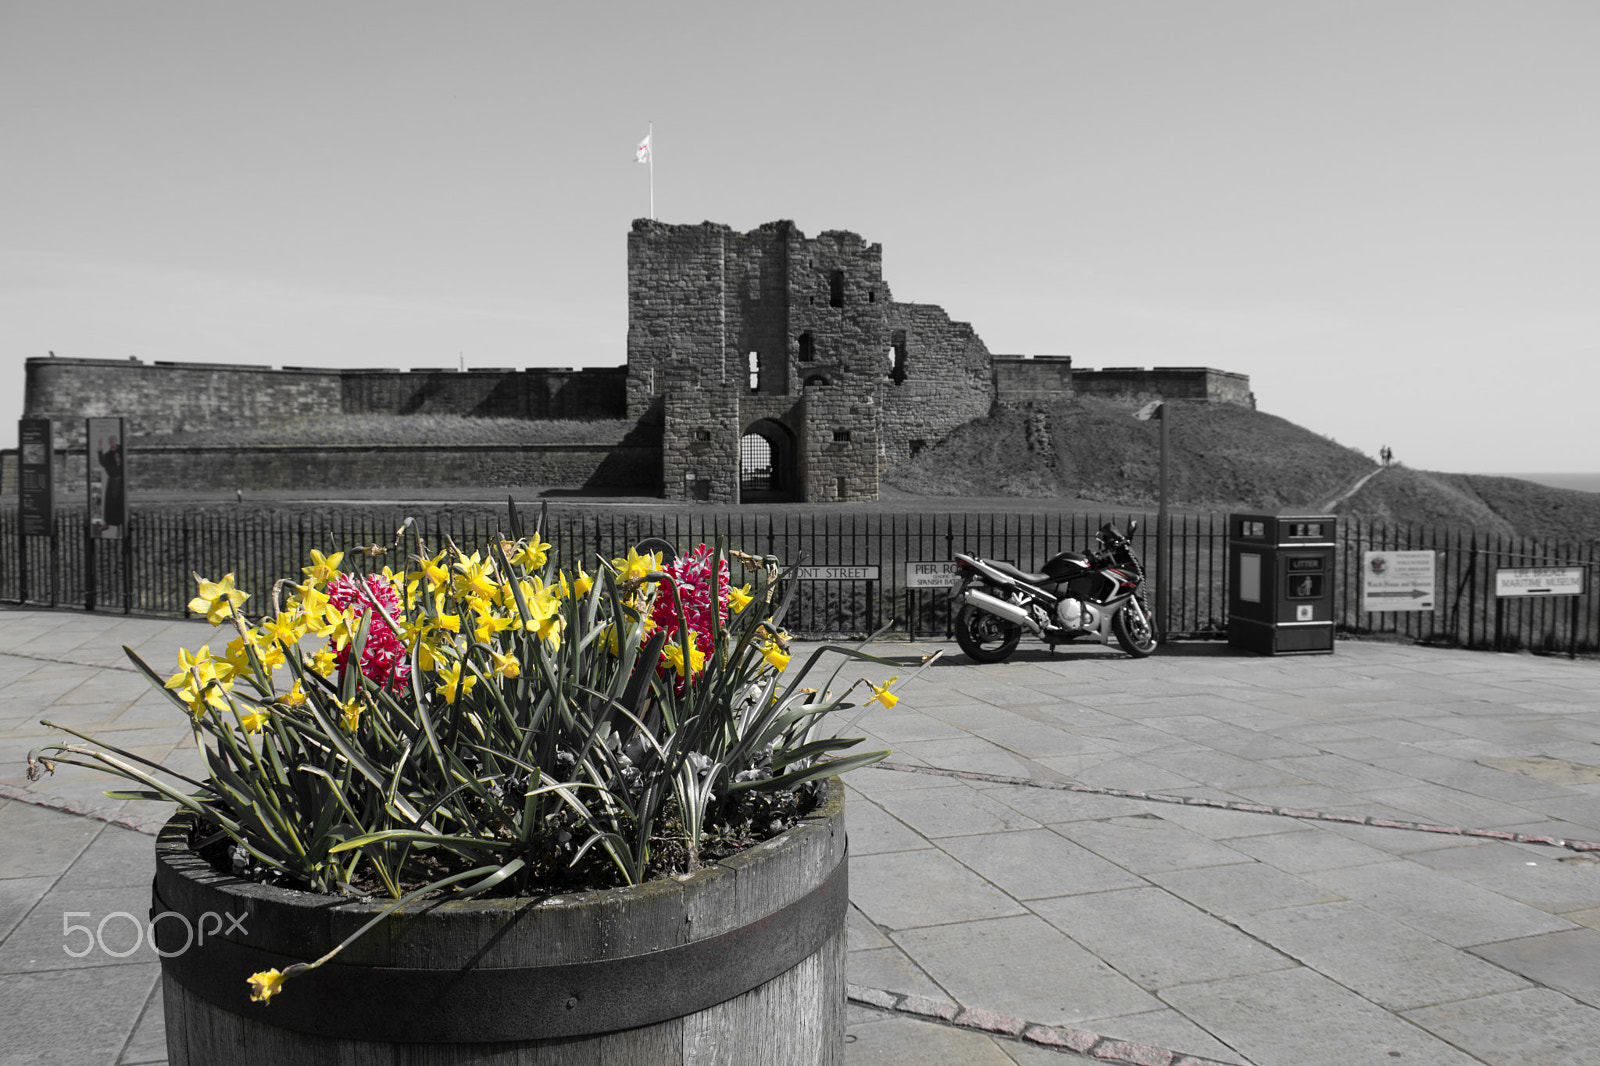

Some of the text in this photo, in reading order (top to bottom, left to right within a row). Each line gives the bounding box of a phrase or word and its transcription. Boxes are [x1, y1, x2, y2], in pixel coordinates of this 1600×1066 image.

[1293, 559, 1319, 568] LITTER
[825, 568, 869, 578] STREET
[915, 564, 937, 574] PIER
[1502, 577, 1581, 587] MARITIME MUSEUM
